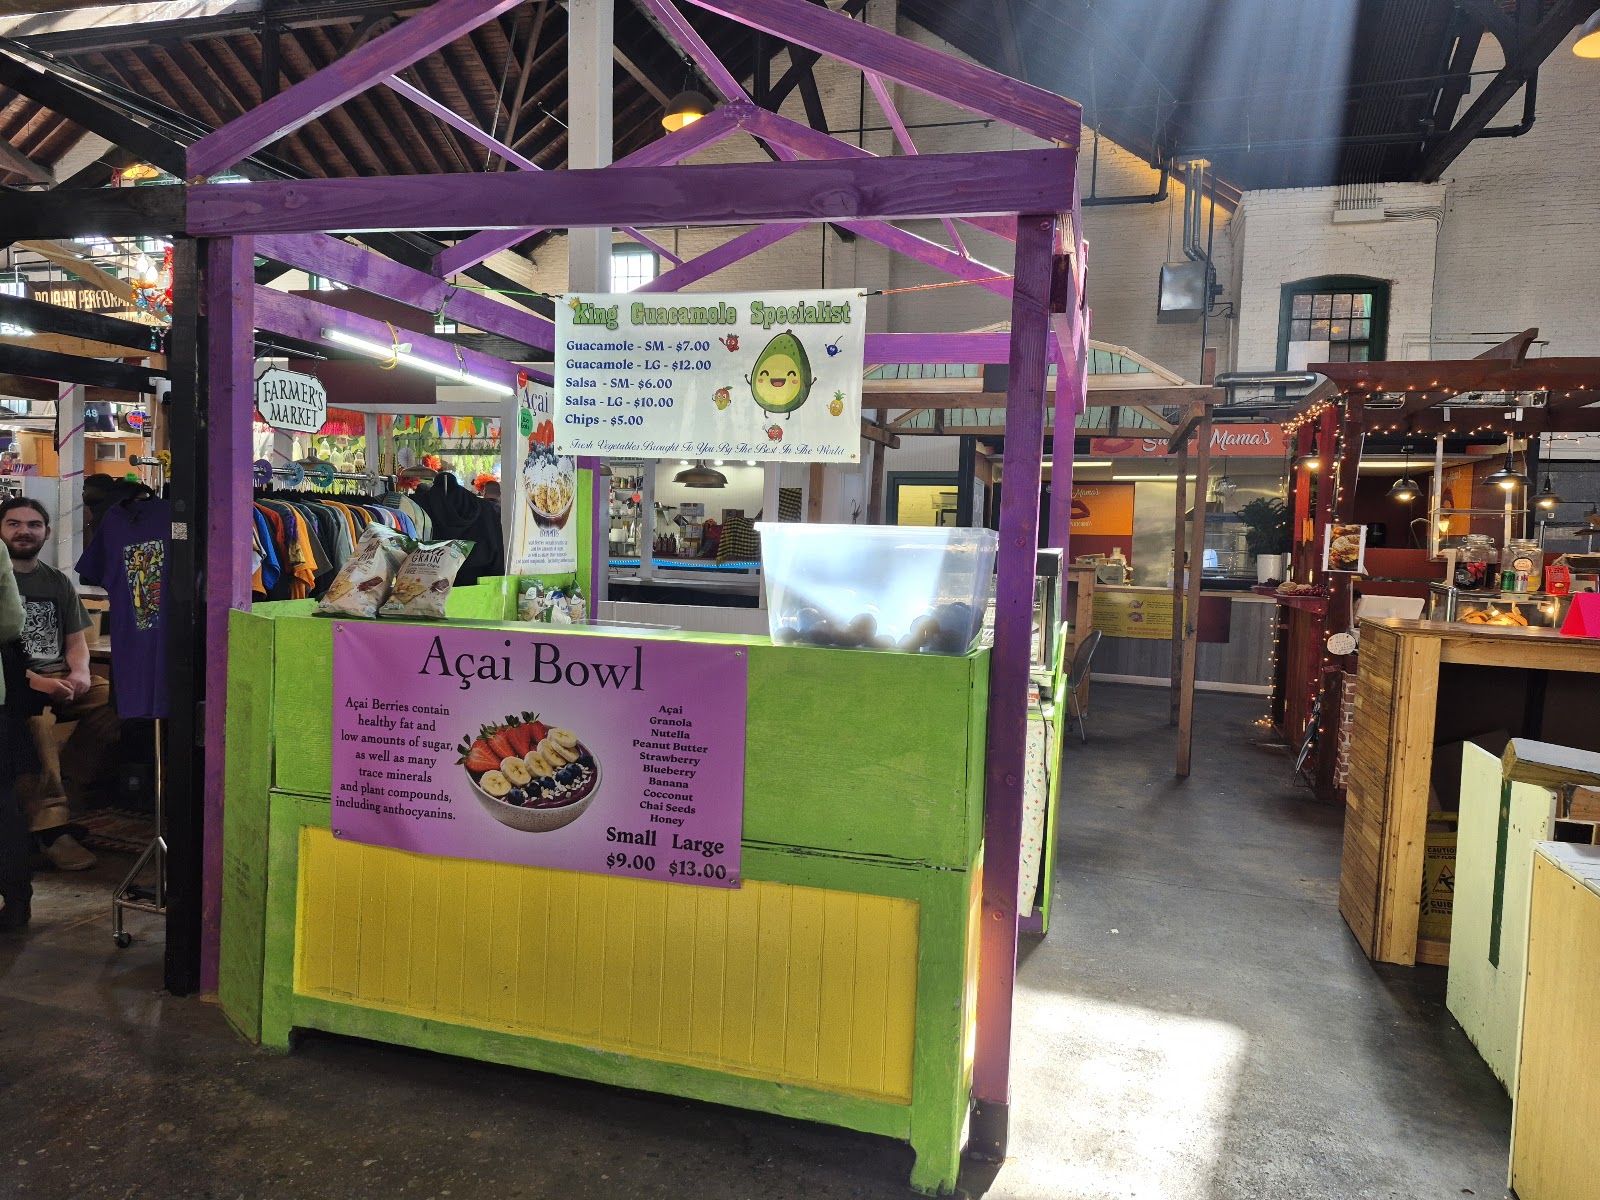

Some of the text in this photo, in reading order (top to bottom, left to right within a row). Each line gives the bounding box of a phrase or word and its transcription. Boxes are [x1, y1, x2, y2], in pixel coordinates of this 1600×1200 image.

[573, 301, 850, 330] King Guacamole Specialist
[566, 341, 634, 351] Guacamole
[645, 341, 664, 351] SM
[676, 341, 710, 352] $7.00
[566, 359, 634, 370] Guacamole
[645, 360, 661, 370] LG
[672, 360, 712, 372] $12.00
[565, 377, 597, 387] Salsa
[638, 378, 673, 390] $6.00
[263, 379, 324, 411] FARMER'S
[565, 396, 596, 406] Salsa
[607, 397, 623, 407] LG
[634, 398, 674, 408] $10.00
[270, 403, 318, 428] MARKET
[565, 414, 600, 427] Chips
[610, 415, 644, 427] $5.00
[570, 438, 845, 456] Fresh Vegetables Brought To You By The Best In The World
[1209, 428, 1273, 451] Mama's
[411, 554, 441, 564] GRAIN
[418, 635, 645, 691] Açai Bowl
[345, 697, 450, 716] Açai Berries contain
[658, 705, 683, 715] Açai
[358, 714, 436, 731] healthy fat and
[649, 717, 692, 727] Granola
[341, 729, 453, 752] low amounts of sugar,
[651, 729, 690, 739] Nutella
[633, 739, 709, 753] Peanut Butter
[355, 750, 437, 769] as well as many
[640, 752, 701, 767] Strawberry
[359, 768, 432, 783] trace minerals
[643, 764, 697, 779] Blueberry
[648, 777, 689, 789] Banana
[340, 781, 452, 803] and plant compounds,
[643, 789, 694, 801] Cocconut
[335, 796, 456, 820] including anthocyanins.
[640, 801, 696, 814] Chai Seeds
[650, 814, 685, 827] Honey
[606, 826, 725, 858] Small Large
[606, 852, 727, 880] $9.00 $13.00
